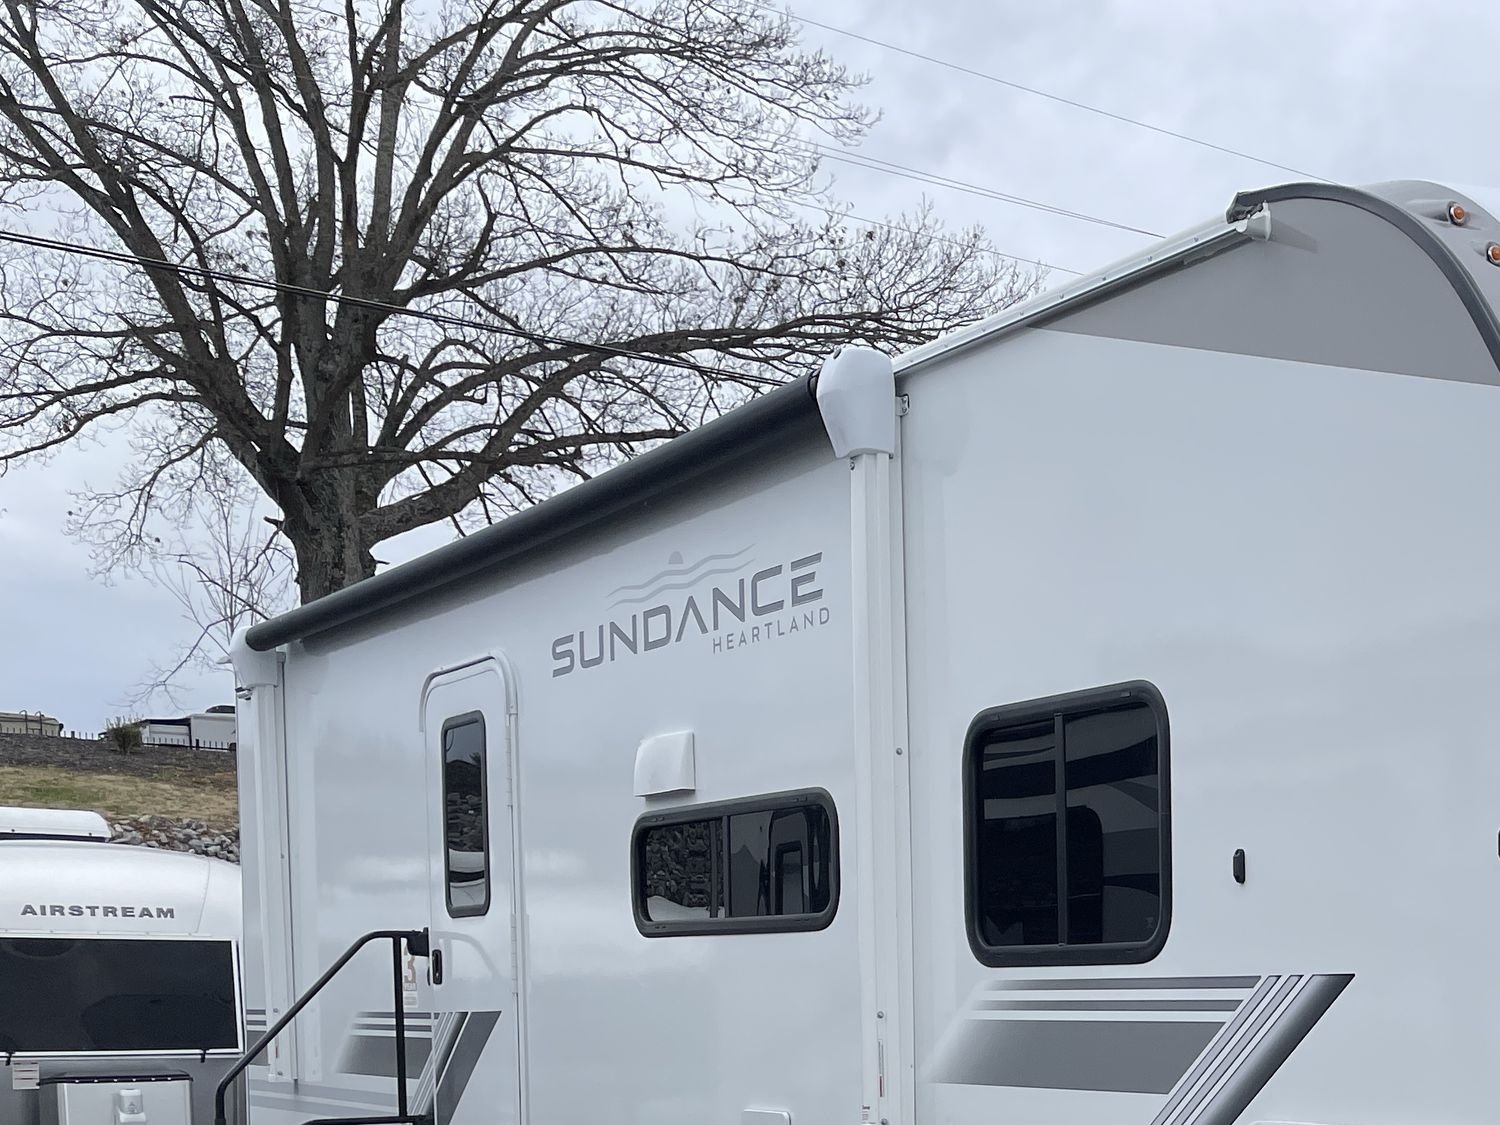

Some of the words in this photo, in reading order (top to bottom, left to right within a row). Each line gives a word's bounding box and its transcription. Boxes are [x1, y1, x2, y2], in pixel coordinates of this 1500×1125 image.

[551, 552, 824, 678] SUNDANCE
[712, 607, 831, 654] HEARTLAND
[20, 904, 176, 919] AIRSTREAM
